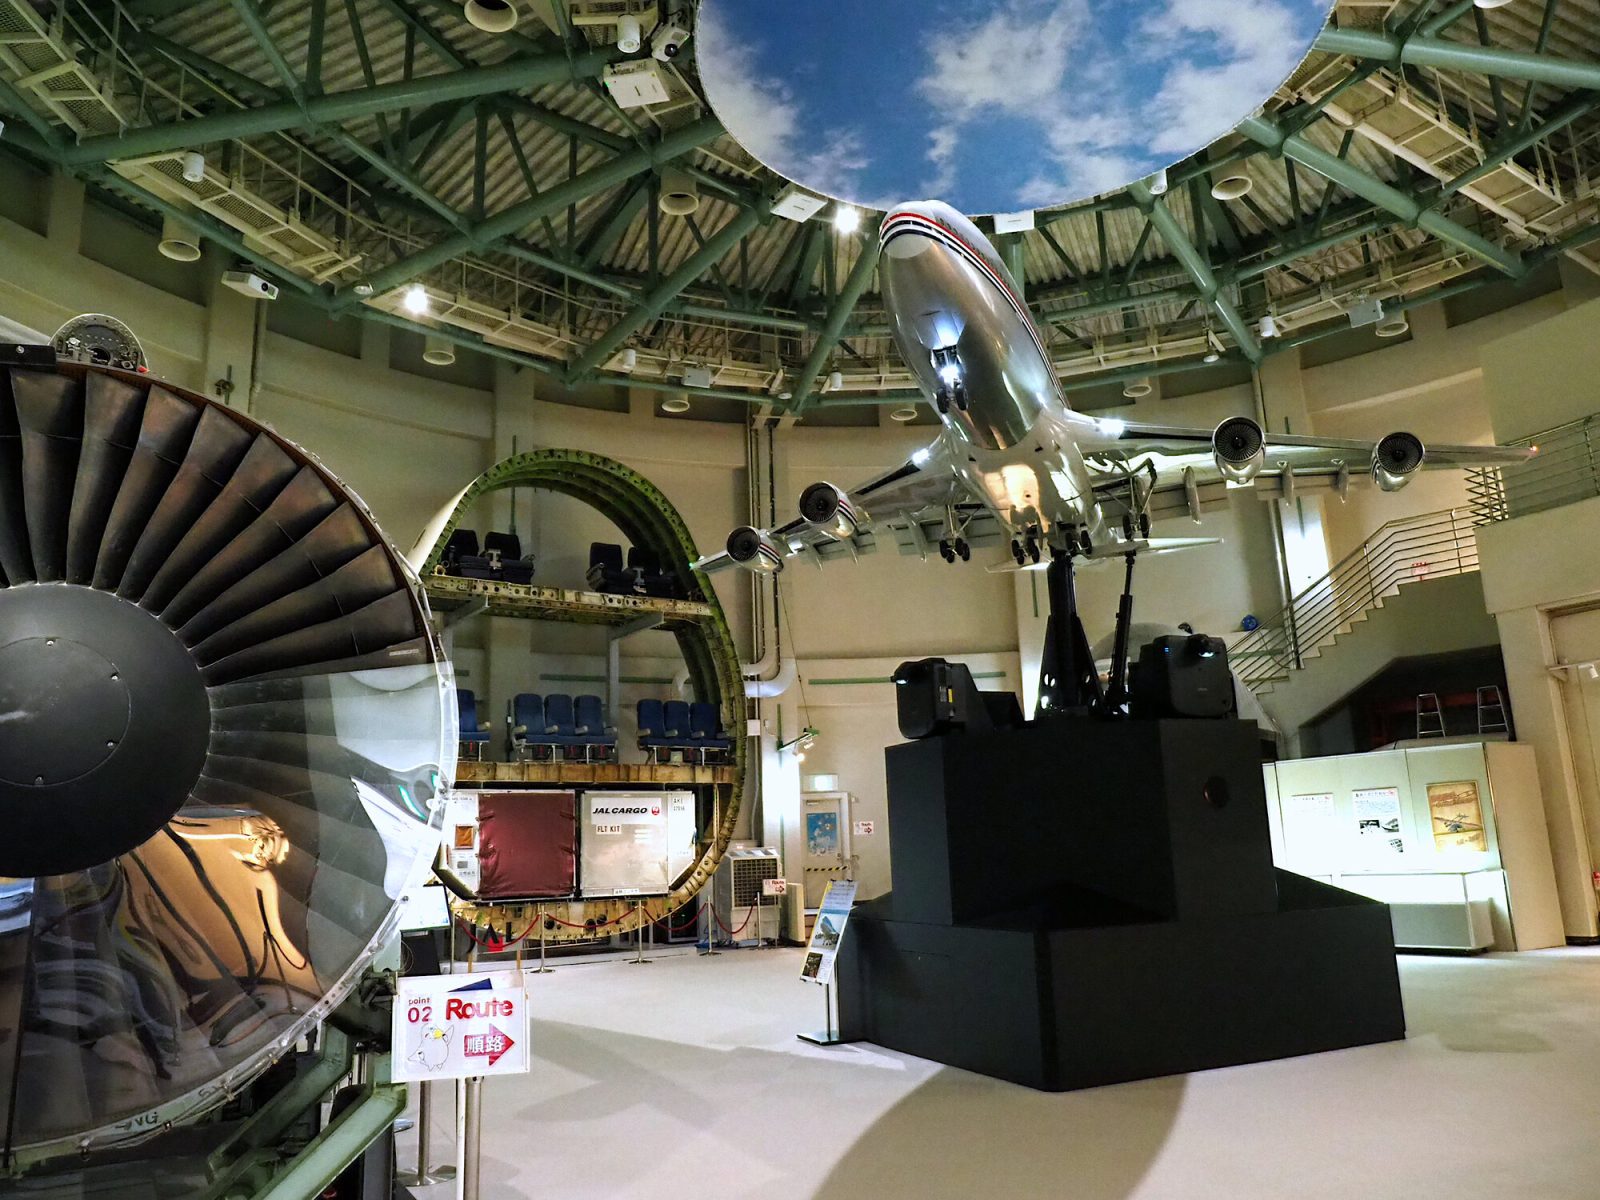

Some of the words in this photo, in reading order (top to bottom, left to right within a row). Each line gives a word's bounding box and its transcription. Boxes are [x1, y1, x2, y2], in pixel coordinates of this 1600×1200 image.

[593, 807, 611, 815] JAL
[408, 997, 430, 1006] point
[445, 997, 513, 1021] Route
[407, 1006, 433, 1023] 02
[466, 1034, 505, 1054] 順路
